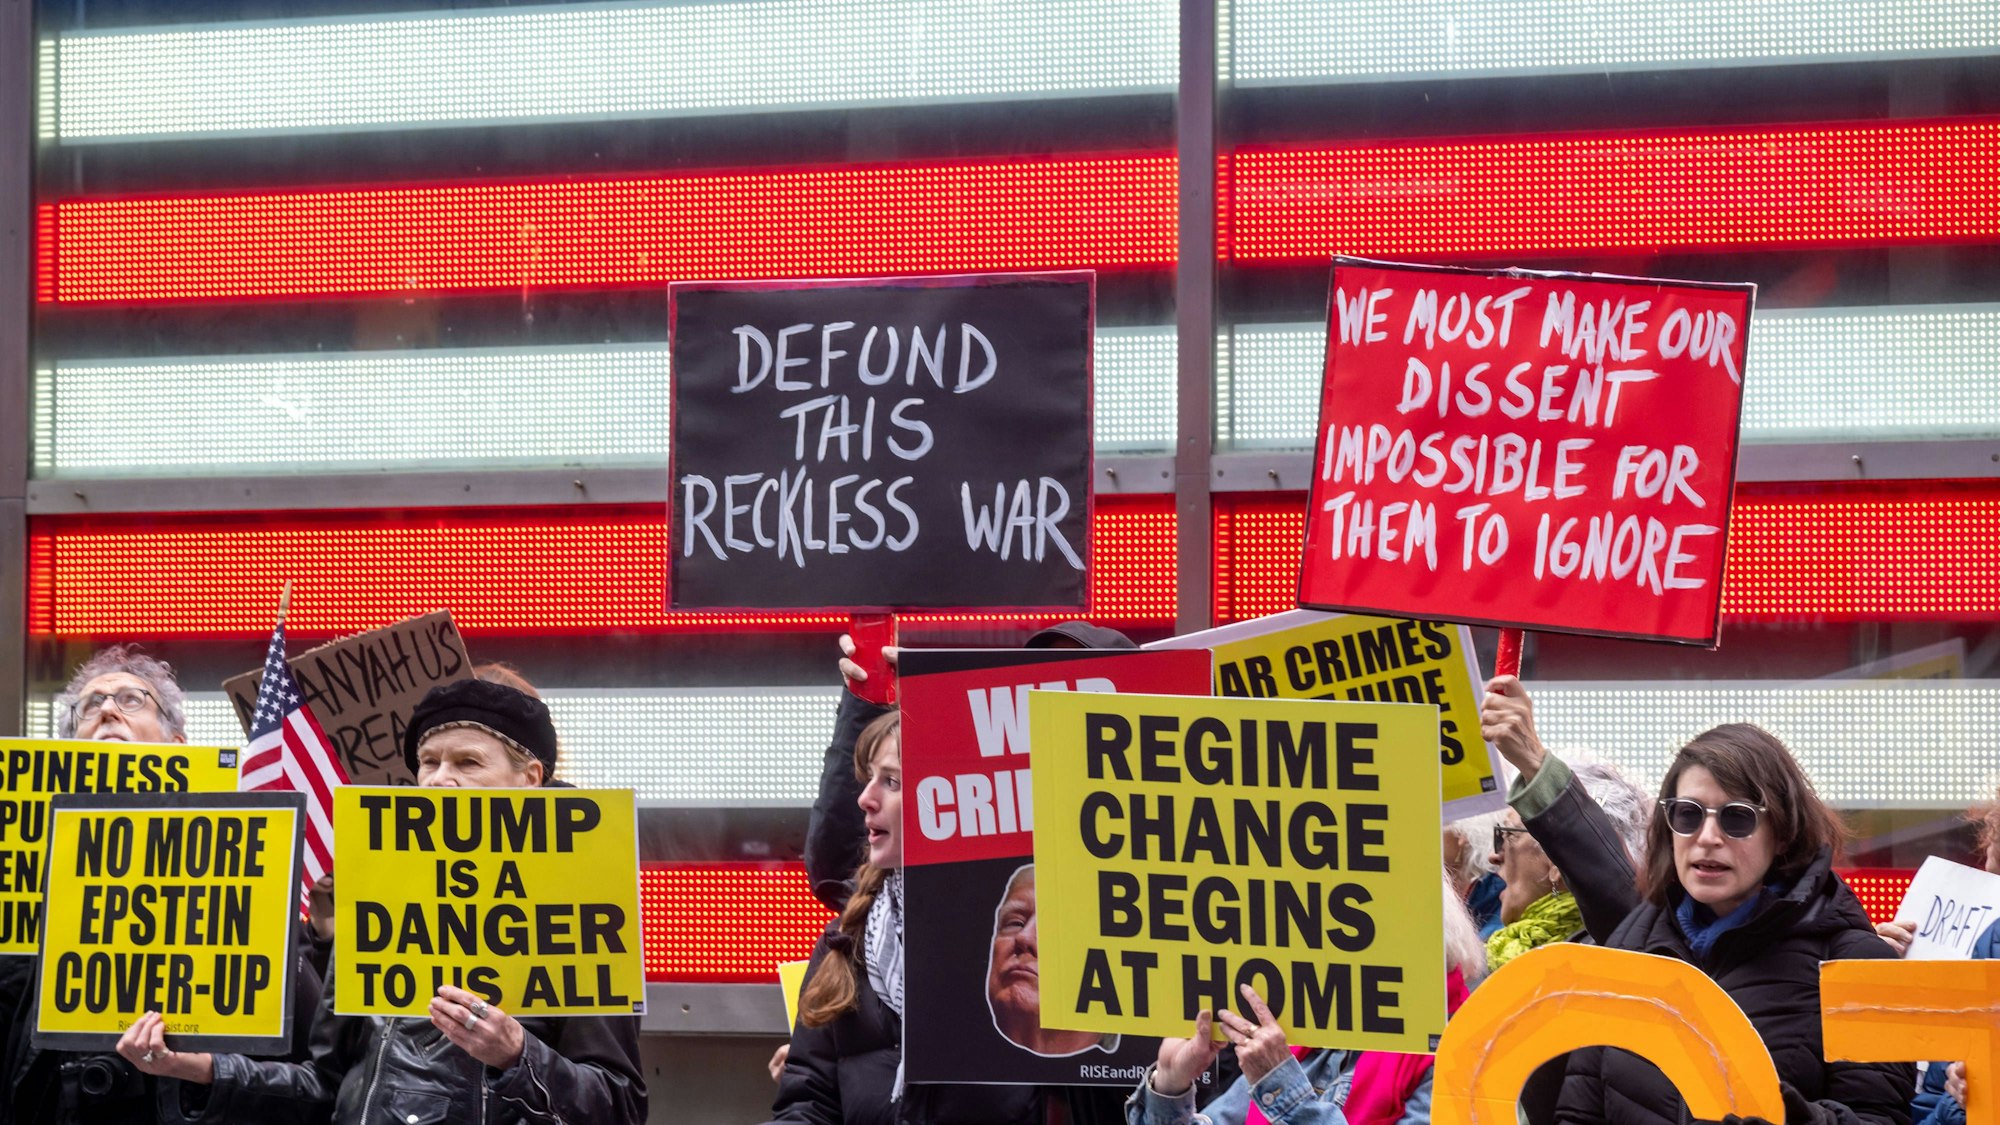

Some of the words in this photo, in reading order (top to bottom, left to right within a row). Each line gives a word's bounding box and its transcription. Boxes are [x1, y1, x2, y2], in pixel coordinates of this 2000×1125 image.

[730, 321, 998, 393] DEFUND
[1337, 287, 1393, 346] WE
[1404, 286, 1533, 350] MUST
[1540, 290, 1651, 364] MAKE
[1659, 307, 1741, 385] OUR
[1396, 357, 1660, 428] DISSENT
[779, 395, 934, 462] THIS
[1322, 423, 1595, 502] IMPOSSIBLE
[1613, 445, 1706, 508] FOR
[681, 465, 920, 567] RECKLESS
[961, 476, 1086, 570] WAR
[1324, 492, 1437, 571] THEM
[1456, 502, 1509, 571] TO
[1534, 511, 1721, 596] IGNORE
[1214, 655, 1278, 697] AR
[1284, 620, 1451, 692] CRIMES
[0, 749, 190, 793] PINELESS
[1086, 713, 1379, 791] REGIME
[76, 816, 134, 878] NO
[145, 816, 267, 878] MORE
[360, 796, 600, 853] TRUMP
[1080, 792, 1390, 873] CHANGE
[80, 884, 252, 946] EPSTEIN
[436, 860, 478, 899] IS
[494, 860, 527, 899] A
[1098, 869, 1377, 952] BEGINS
[356, 901, 627, 957] DANGER
[1919, 894, 1993, 956] DRAFT
[54, 951, 271, 1016] COVER-UP
[356, 963, 416, 1008] TO
[432, 965, 503, 1007] US
[521, 964, 629, 1008] ALL
[1075, 948, 1159, 1017] AT
[1182, 954, 1405, 1035] HOME
